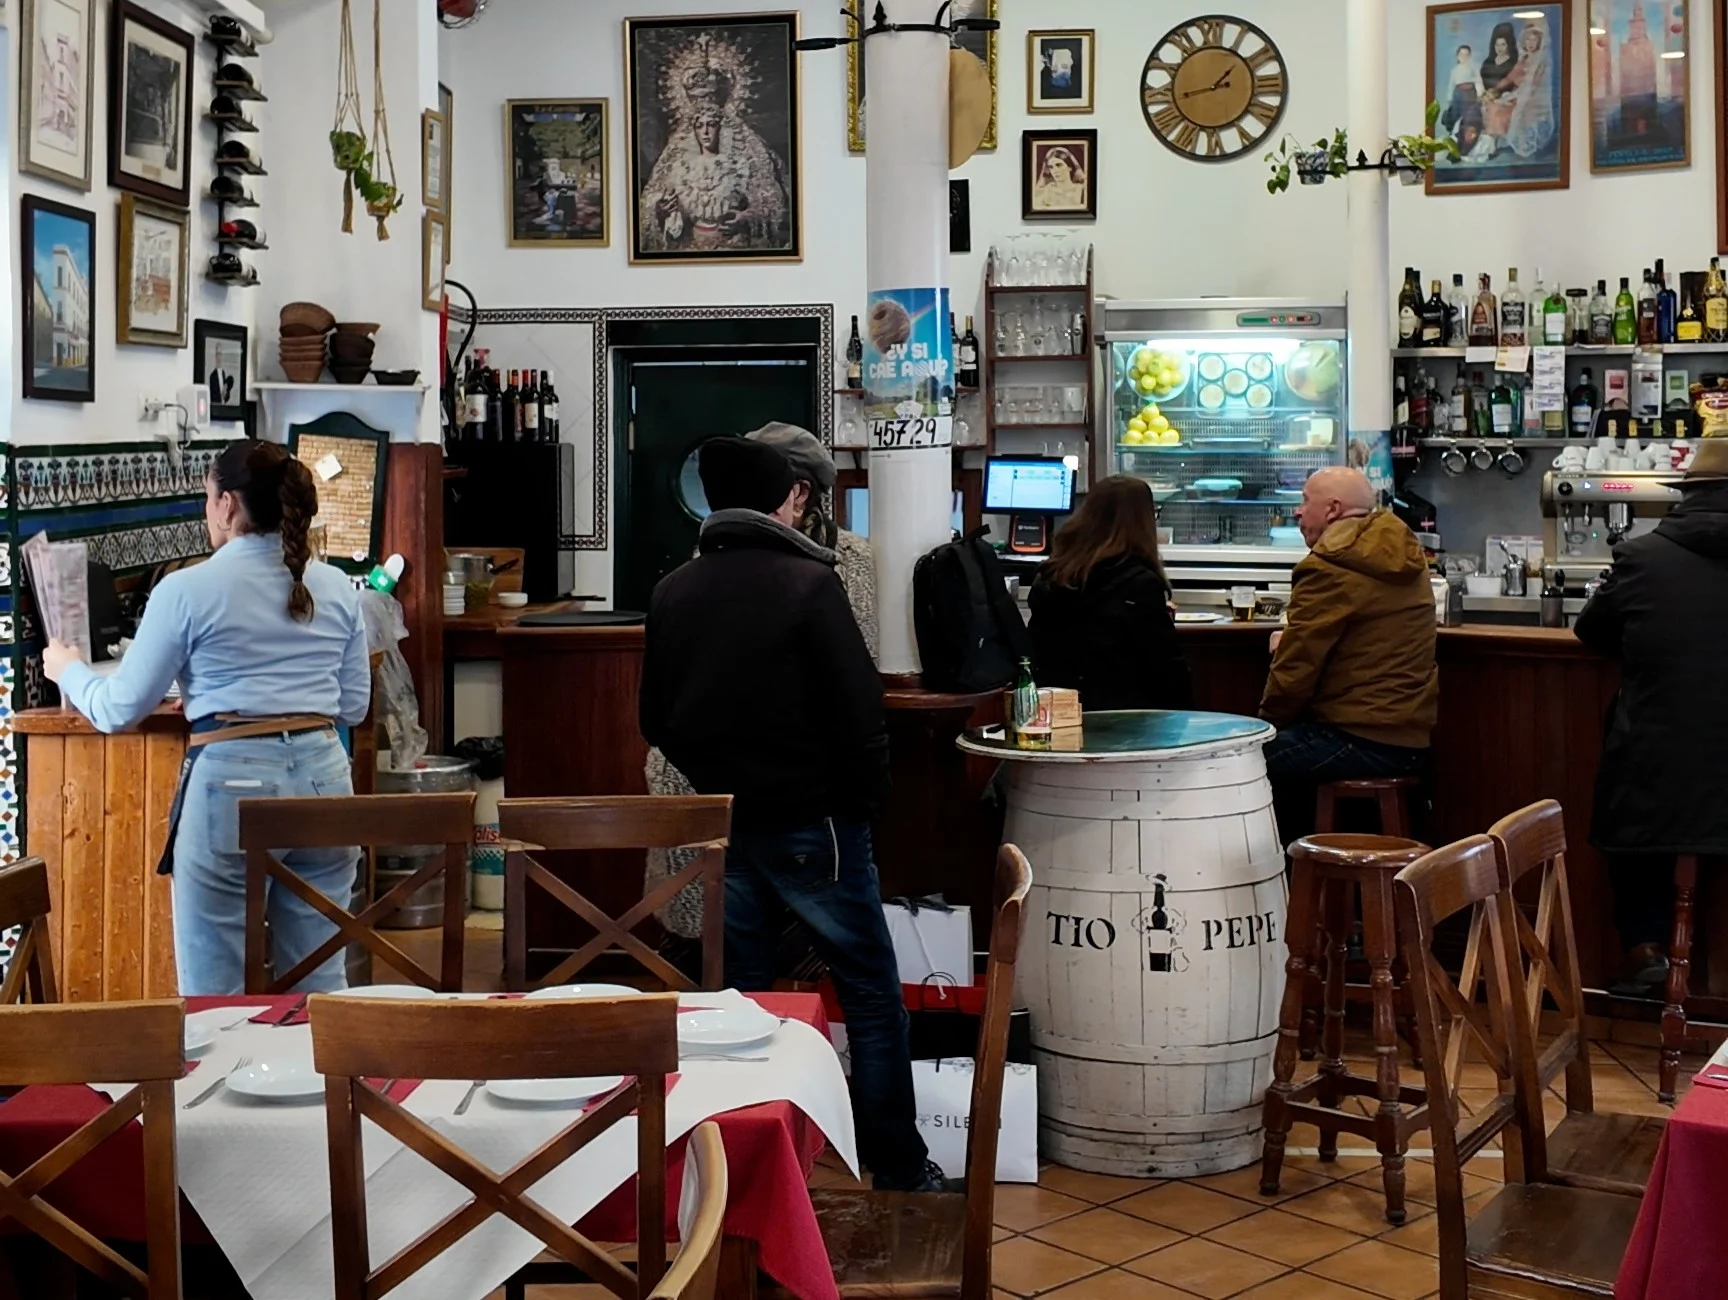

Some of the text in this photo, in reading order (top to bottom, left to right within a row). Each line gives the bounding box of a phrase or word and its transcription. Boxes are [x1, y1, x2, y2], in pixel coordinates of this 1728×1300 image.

[911, 342, 928, 359] SI
[869, 362, 897, 379] CAE
[1046, 911, 1277, 950] TIO PEPE
